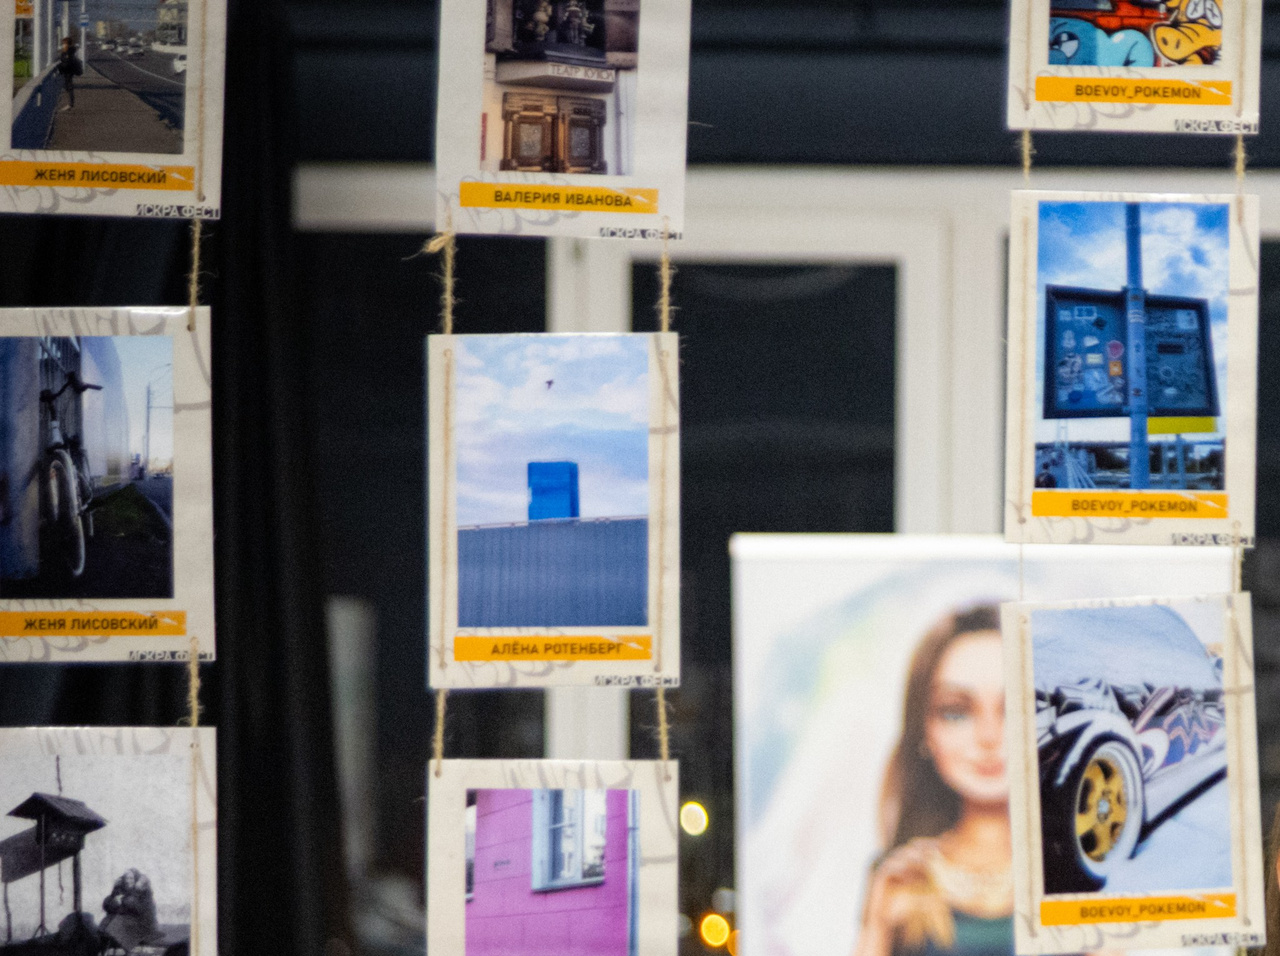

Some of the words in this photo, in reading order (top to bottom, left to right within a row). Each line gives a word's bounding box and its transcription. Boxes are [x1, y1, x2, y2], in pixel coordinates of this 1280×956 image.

[1075, 84, 1201, 99] BOEVOY_POKEMON
[35, 168, 76, 181] ЖЕНЯ
[80, 169, 166, 184] ЛИСОВСКИЙ
[494, 190, 560, 204] ВАЛЕРИЯ
[566, 193, 632, 207] ИВАНОВА
[136, 204, 181, 217] ИСКРА
[181, 205, 219, 219] ФЕСТ
[1072, 499, 1198, 514] BOEVOY_POKEMON
[24, 618, 66, 631] ЖЕНЯ
[70, 615, 159, 631] ЛИСОВСКИЙ
[491, 640, 539, 655] АЛЁНА
[544, 643, 624, 655] РОТЕНБЕРГ
[1080, 901, 1206, 918] BOEVOY_POKEMON
